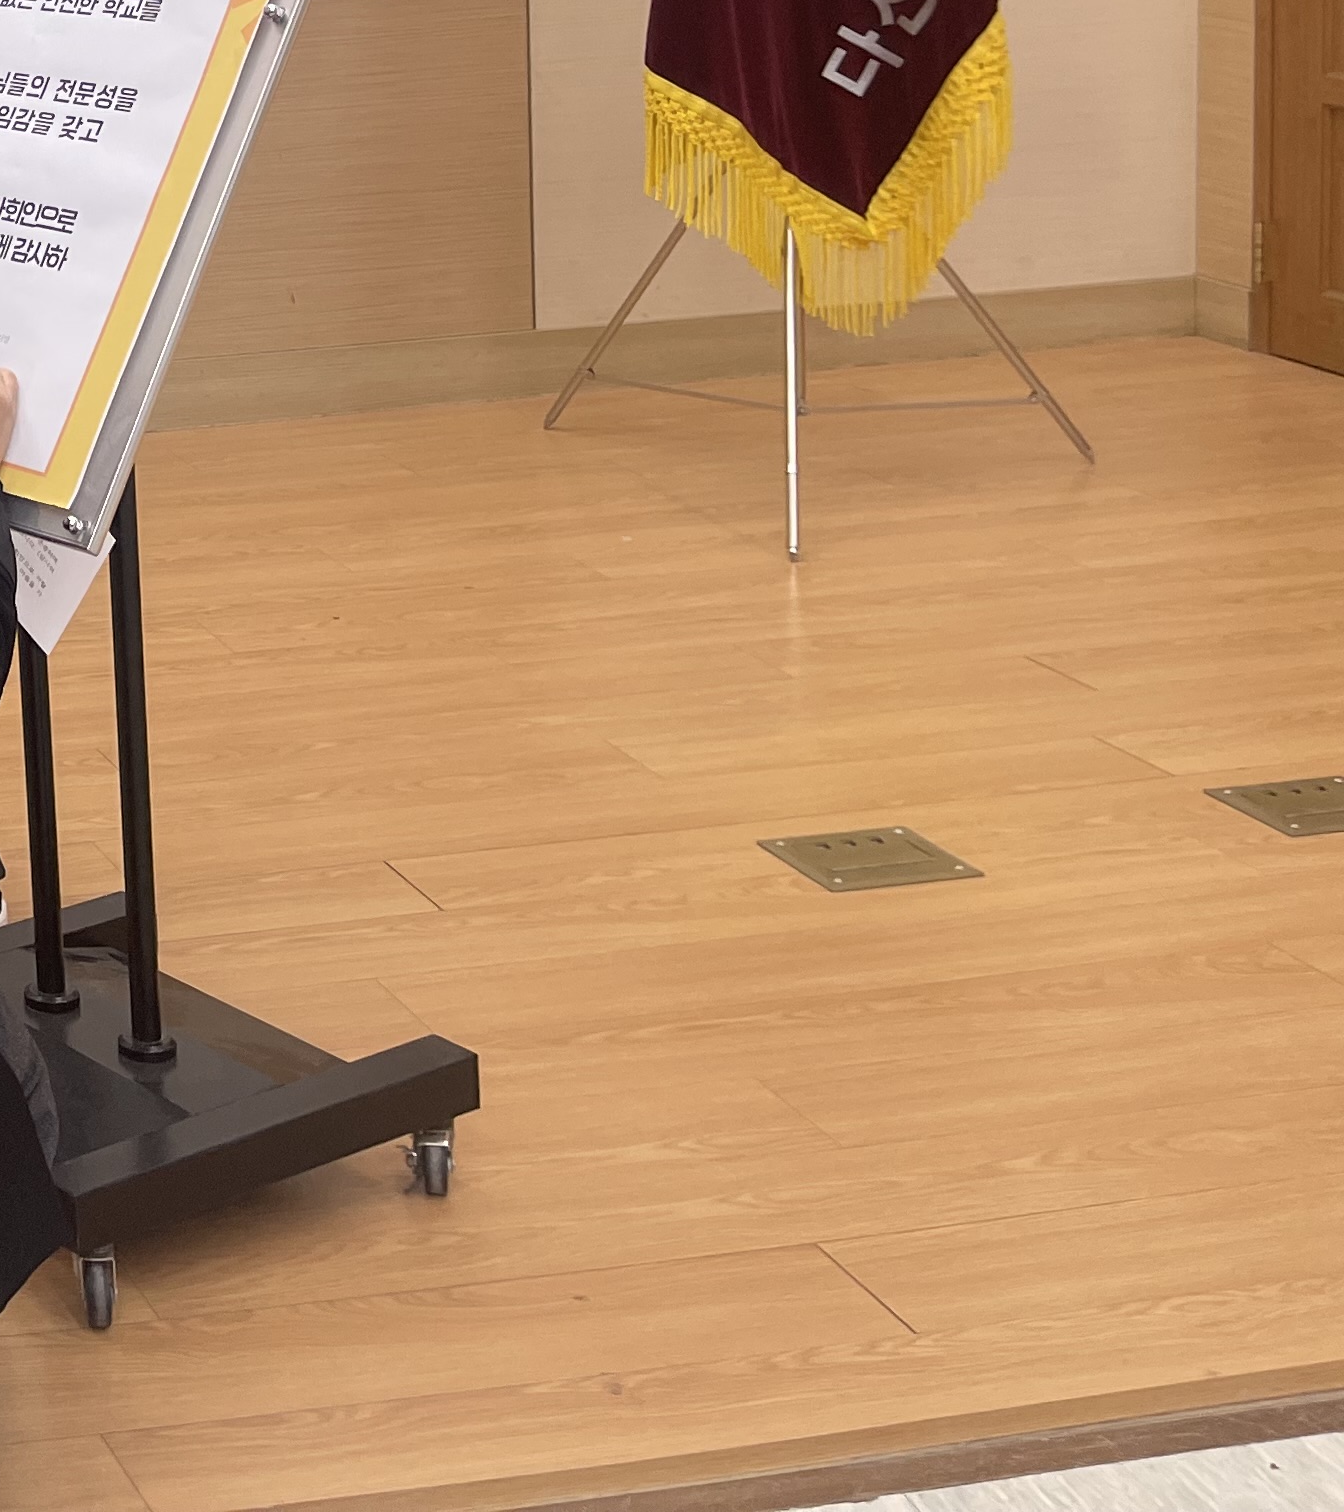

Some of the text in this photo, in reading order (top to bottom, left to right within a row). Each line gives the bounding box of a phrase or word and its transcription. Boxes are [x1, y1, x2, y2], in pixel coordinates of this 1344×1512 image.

[53, 78, 139, 113] 전문성을
[58, 114, 104, 143] 갖고
[10, 236, 69, 271] 감사하
